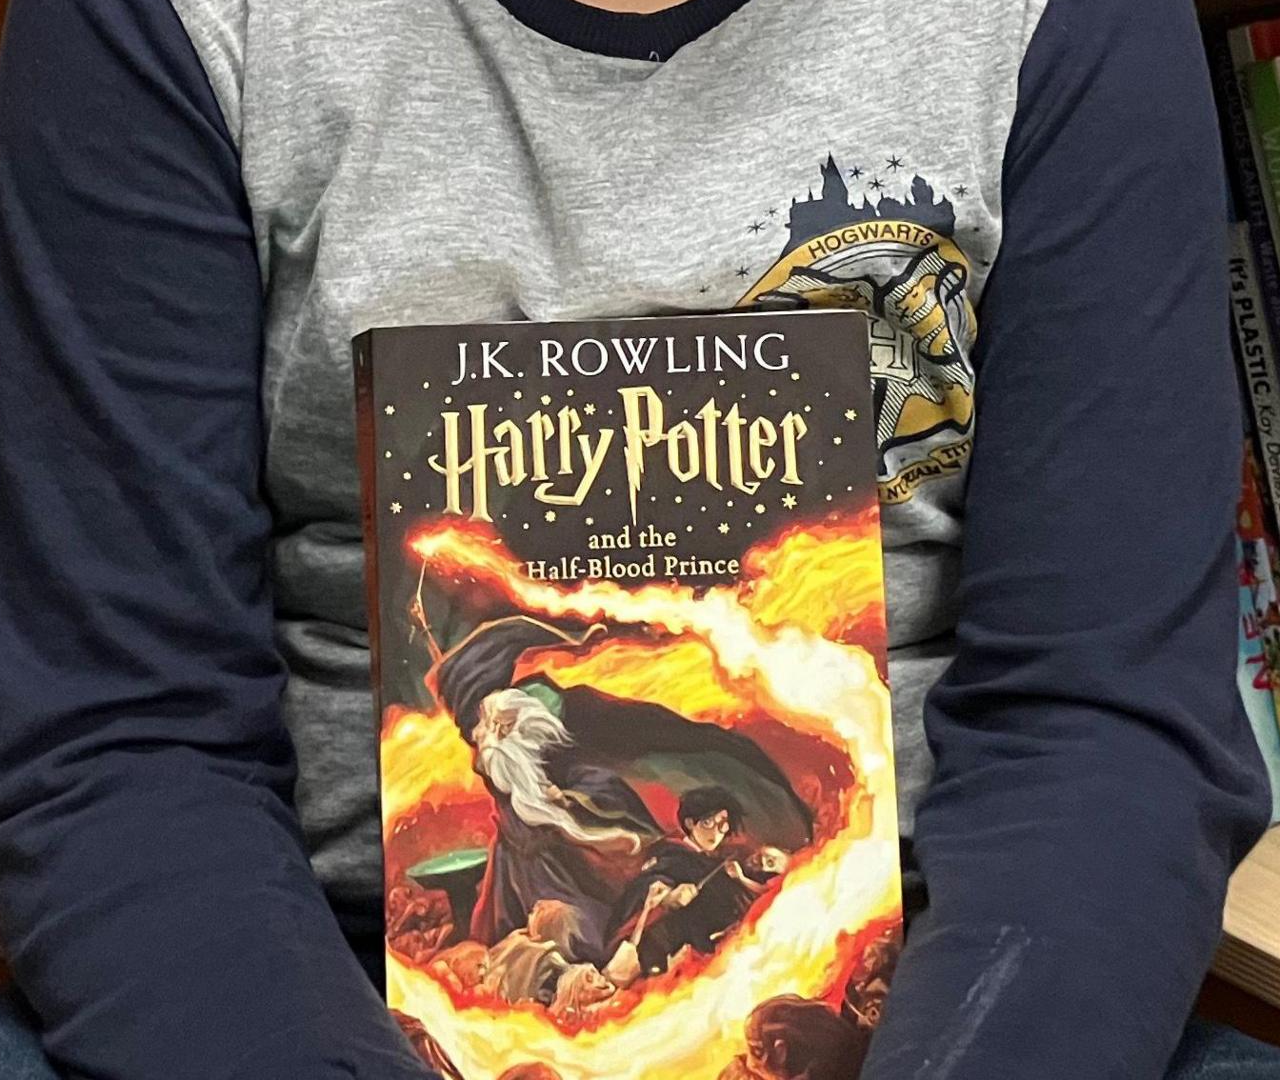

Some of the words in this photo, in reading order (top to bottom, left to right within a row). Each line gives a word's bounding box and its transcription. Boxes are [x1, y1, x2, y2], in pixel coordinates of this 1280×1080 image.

[806, 225, 936, 261] HOGWARTS
[451, 339, 525, 387] J.K.
[540, 332, 791, 378] ROWLING
[1233, 296, 1271, 396] PLASTIC
[1253, 402, 1277, 438] Kay
[427, 402, 614, 523] Harry
[616, 385, 809, 527] Potter
[587, 530, 631, 551] and
[639, 528, 678, 549] the
[526, 555, 658, 581] Half-Blood
[664, 555, 741, 578] Prince
